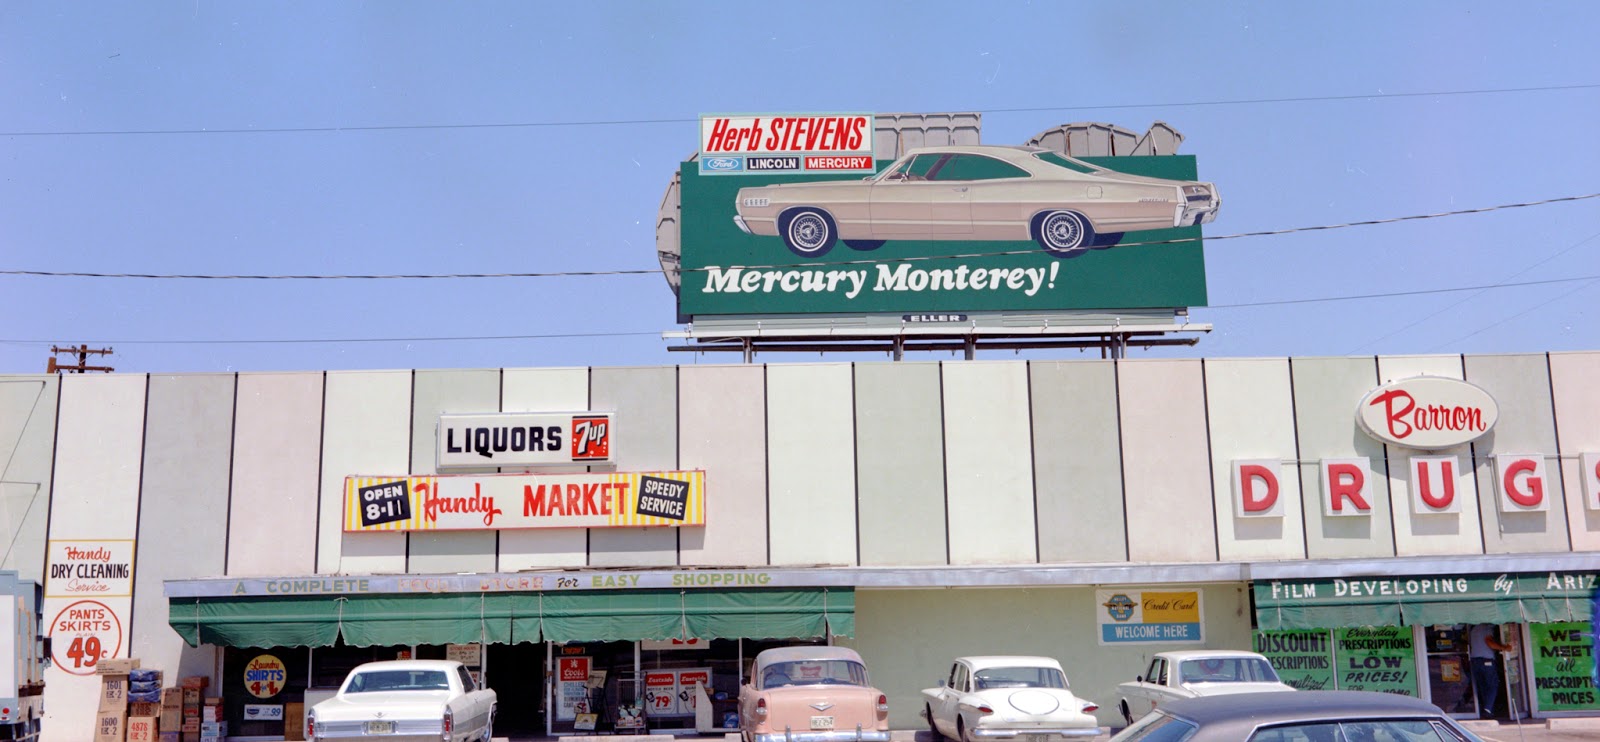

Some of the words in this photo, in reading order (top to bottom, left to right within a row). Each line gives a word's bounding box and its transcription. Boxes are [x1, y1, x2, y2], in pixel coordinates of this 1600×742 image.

[706, 118, 763, 152] Herb
[765, 117, 867, 151] STEVENS
[749, 158, 797, 169] LINCOLN
[808, 157, 868, 169] MERCURY
[702, 265, 868, 299] Mercury
[873, 261, 1060, 297] Monterey!
[910, 314, 962, 323] ELLER
[1369, 389, 1487, 439] Barron
[446, 425, 563, 459] LIQUORS
[644, 479, 685, 498] SPEEDY
[1239, 458, 1600, 512] DRUG
[364, 485, 403, 502] OPEN
[412, 481, 503, 526] Handy
[523, 482, 631, 517] MARKET
[639, 495, 684, 516] SERVICE
[65, 546, 111, 563] Handy
[51, 563, 75, 579] DRY
[76, 563, 130, 579] CLEANING
[65, 578, 111, 592] Service
[233, 581, 247, 594] A
[266, 579, 370, 594] COMPLETE
[591, 574, 641, 588] EASY
[672, 572, 772, 587] SHOPPING
[1271, 581, 1317, 599] FILM
[1334, 578, 1469, 597] DEVELOPING
[1493, 574, 1514, 595] by
[1143, 599, 1171, 611] Credit
[1171, 599, 1196, 611] Card
[69, 609, 105, 620] PANTS
[59, 620, 112, 632] SKIRTS
[1115, 625, 1161, 638] WELCOME
[1163, 625, 1189, 638] HERE
[1257, 632, 1328, 653] DISCOUNT
[1549, 629, 1582, 642] WE
[1339, 638, 1411, 651] PRESCRIPTIONS
[1540, 645, 1593, 658] MEET
[1350, 656, 1403, 669] LOW
[246, 669, 284, 682] SHIRTS
[1344, 671, 1408, 684] PRICES!
[250, 681, 261, 696] 4
[1552, 691, 1595, 705] PRICES
[101, 717, 118, 727] 1600
